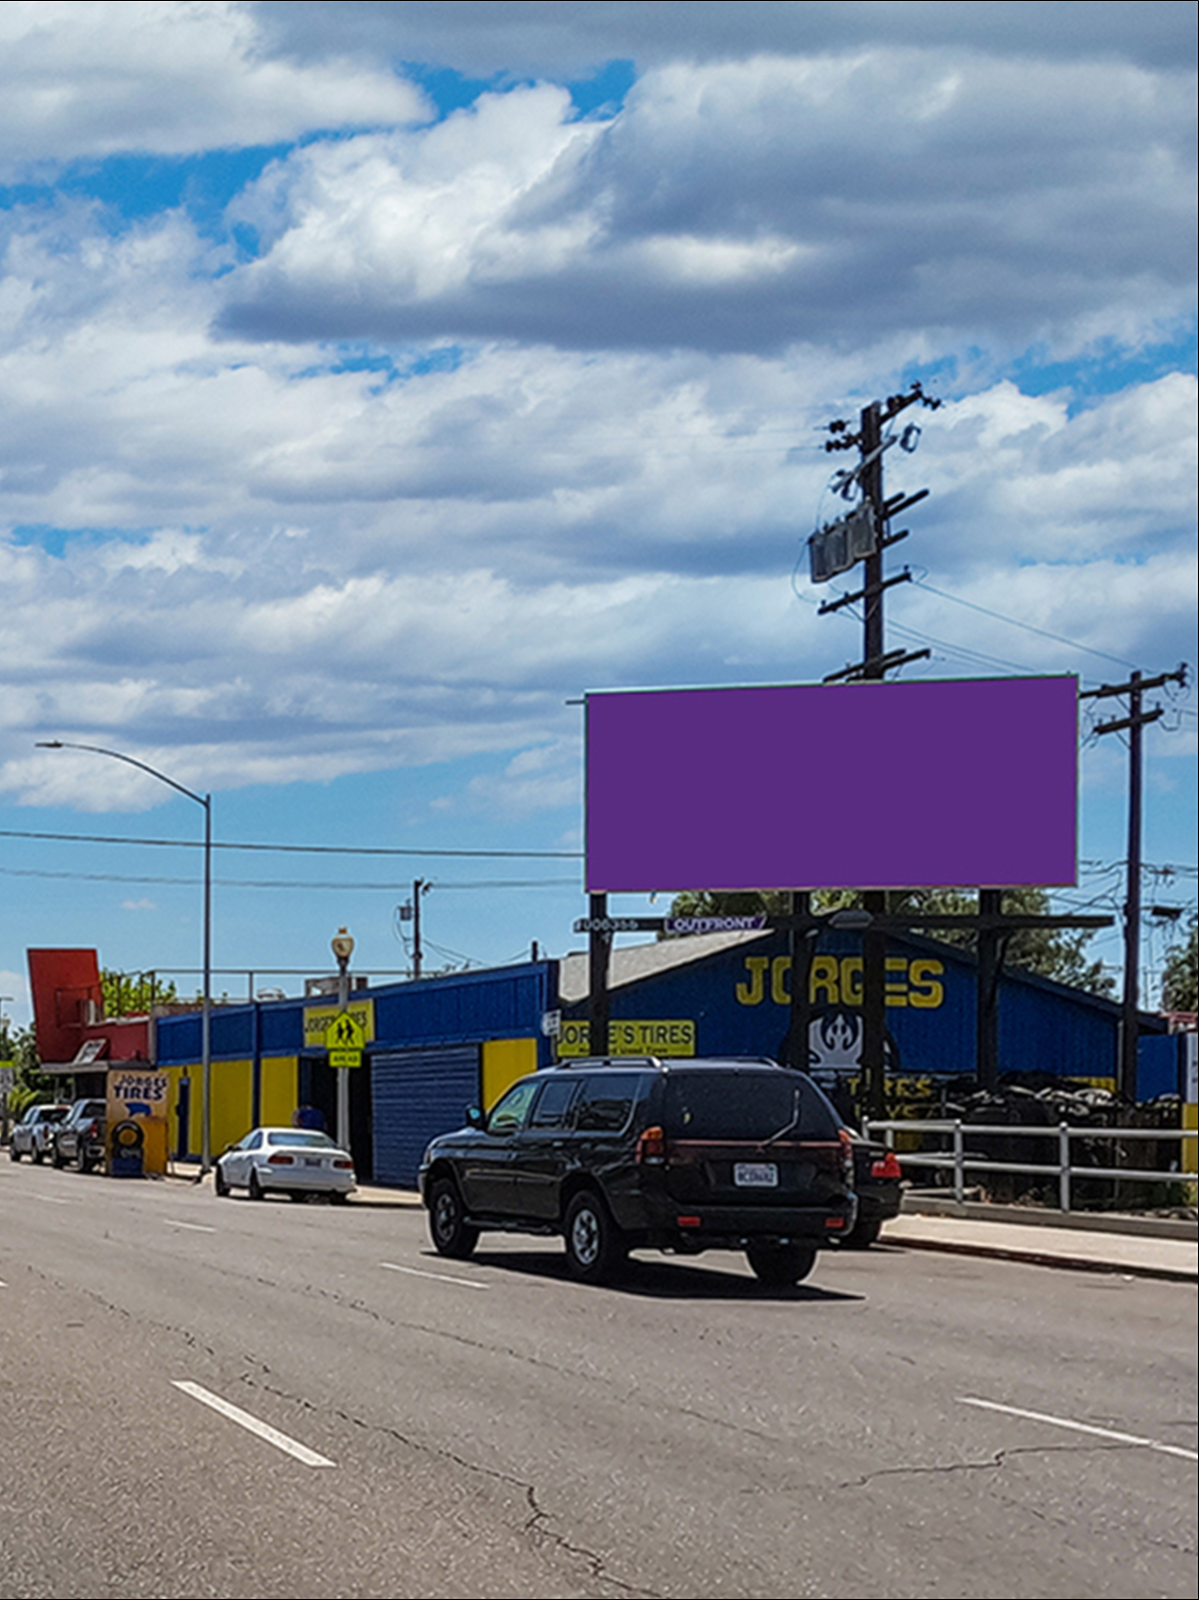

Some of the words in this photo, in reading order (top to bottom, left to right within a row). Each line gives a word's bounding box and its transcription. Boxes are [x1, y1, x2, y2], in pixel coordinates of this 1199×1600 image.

[673, 916, 755, 932] OUTFRONT
[735, 955, 945, 1009] JORGES
[556, 1024, 635, 1045] JORE'S
[638, 1024, 693, 1045] TIRES
[114, 1085, 163, 1100] TIRES
